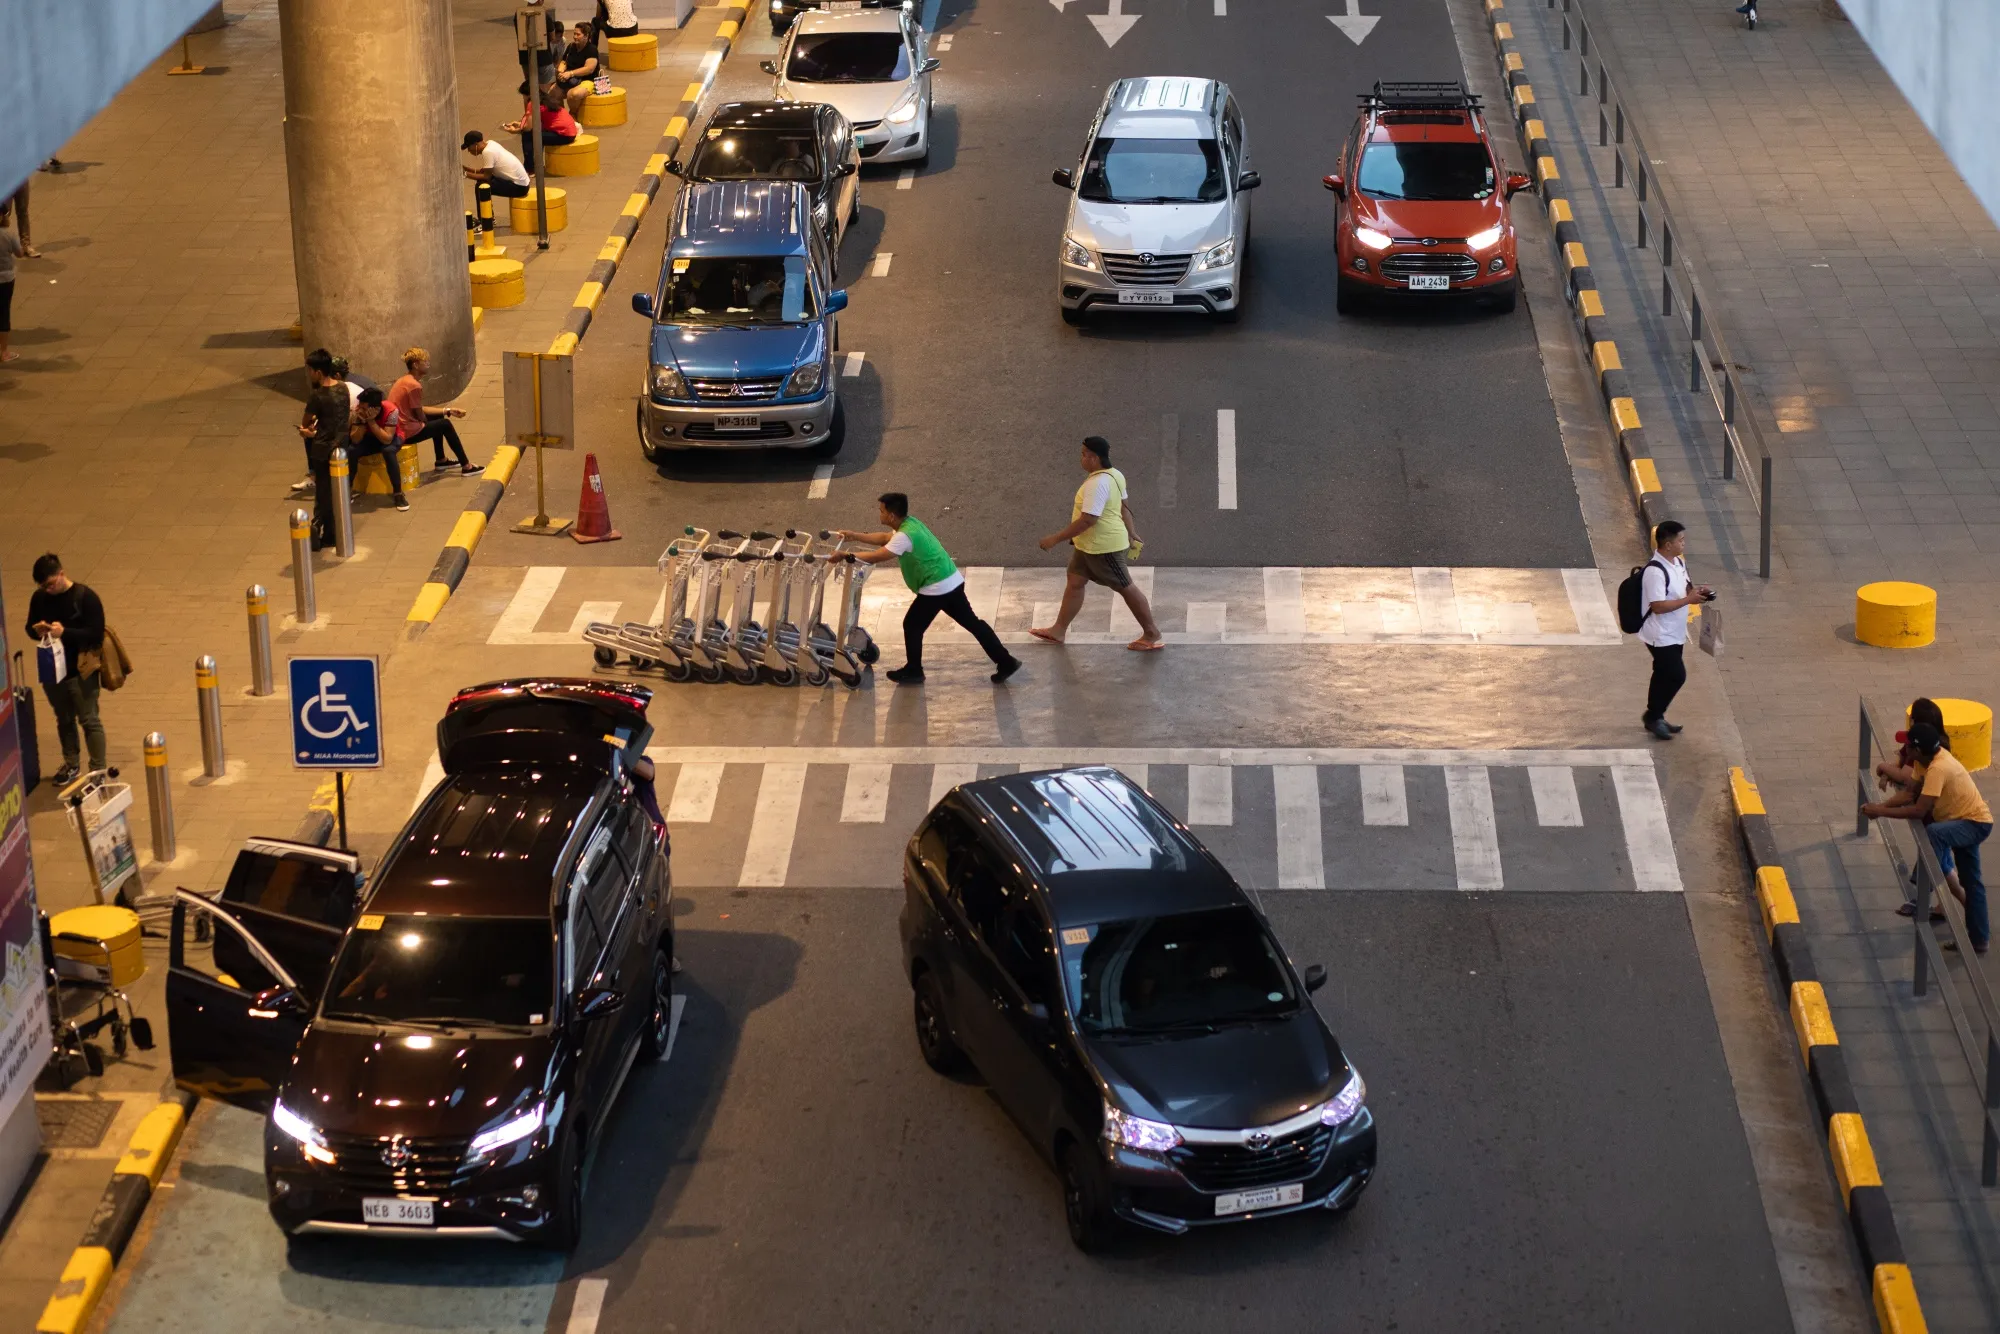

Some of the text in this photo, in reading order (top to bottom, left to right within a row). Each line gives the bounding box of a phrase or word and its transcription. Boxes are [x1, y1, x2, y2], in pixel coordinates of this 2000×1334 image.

[1411, 277, 1448, 286] AAH 2438
[332, 752, 376, 760] Management
[0, 783, 21, 841] eno
[8, 1043, 28, 1084] Health
[28, 1021, 43, 1050] Care
[364, 1204, 431, 1219] NEB 3603
